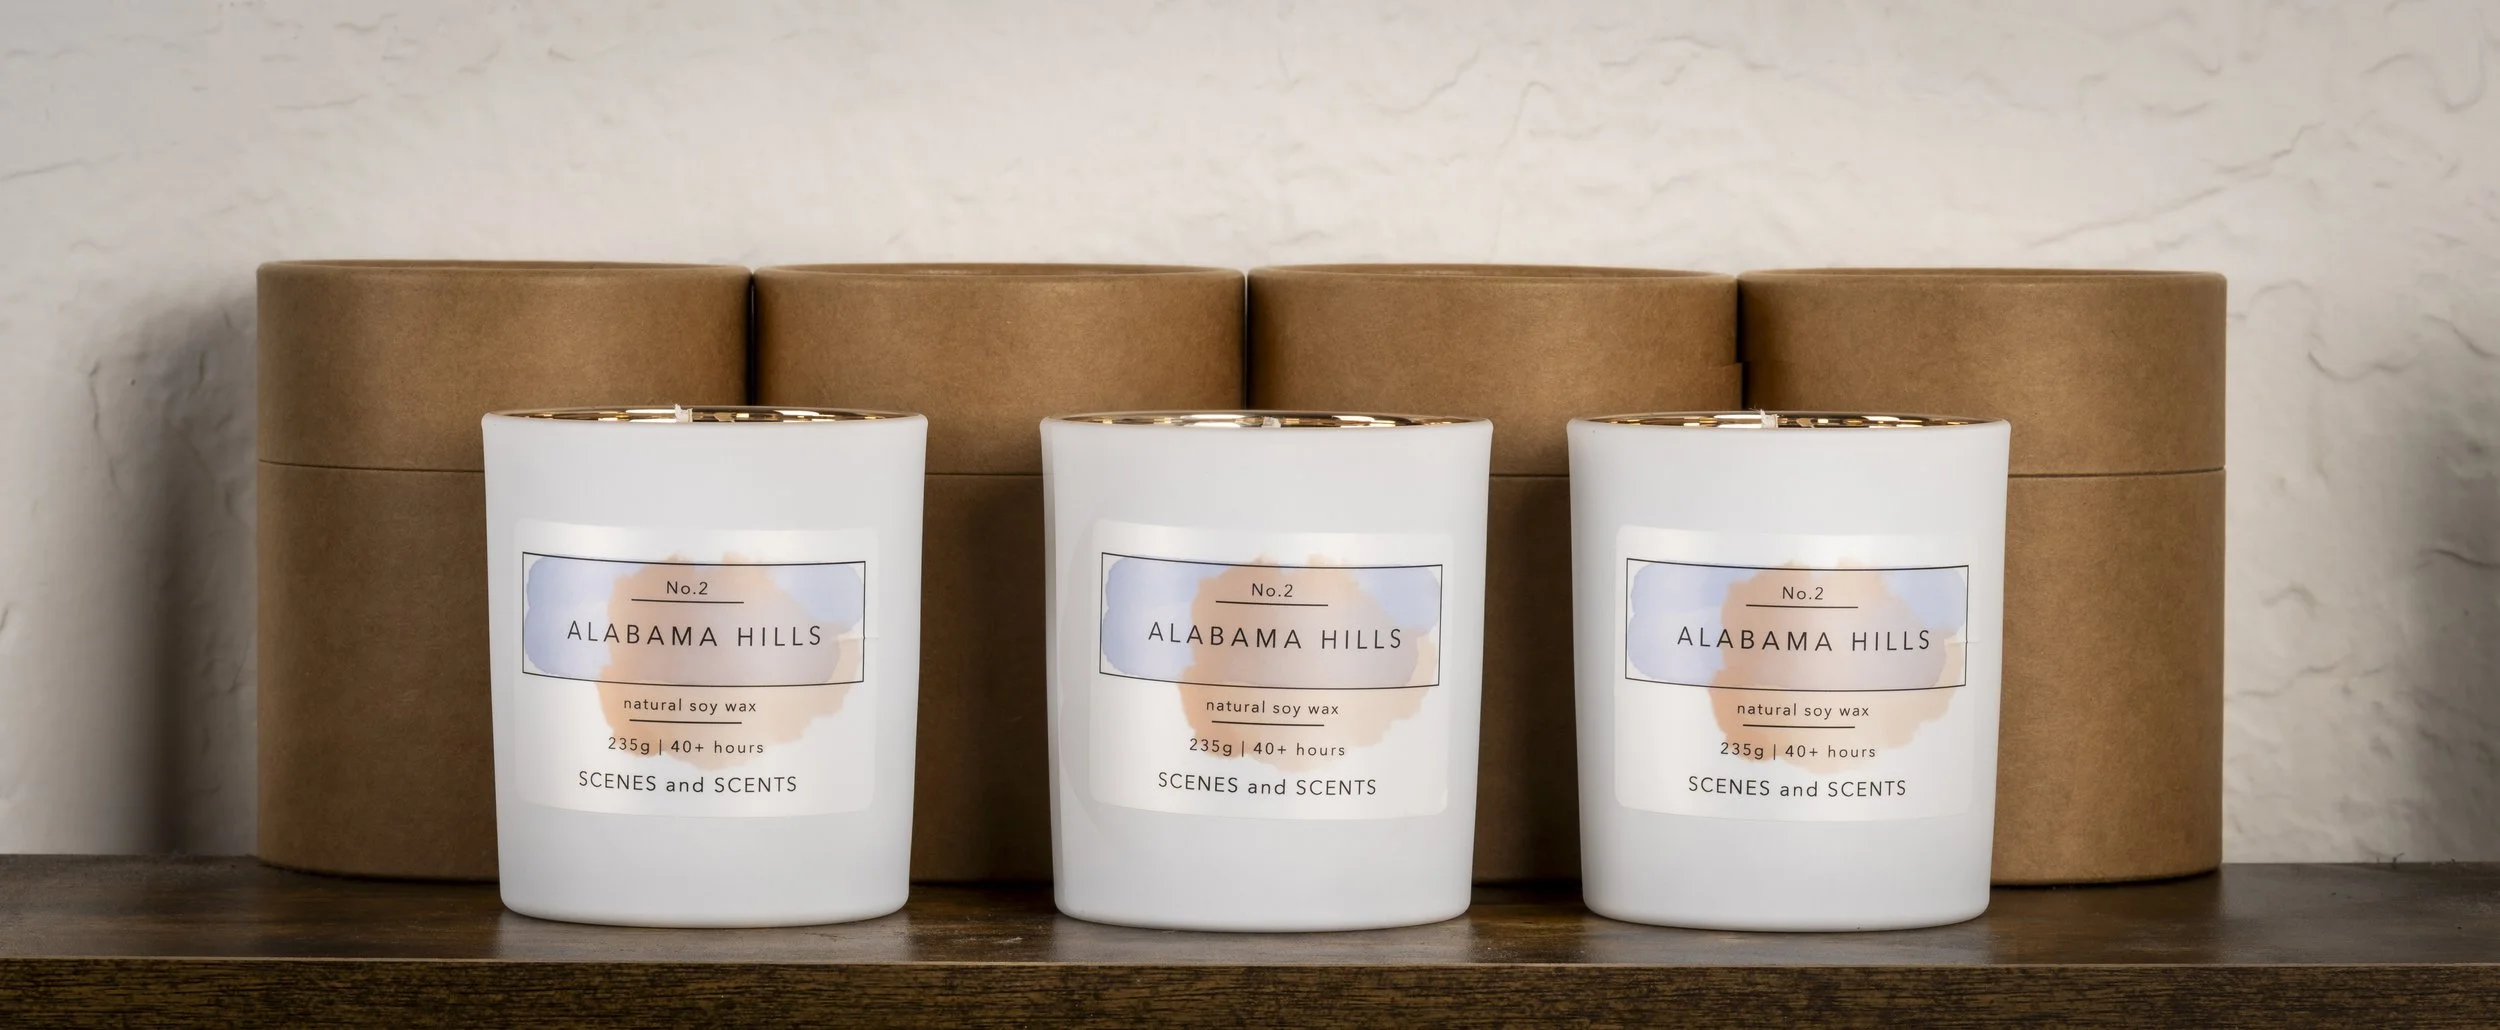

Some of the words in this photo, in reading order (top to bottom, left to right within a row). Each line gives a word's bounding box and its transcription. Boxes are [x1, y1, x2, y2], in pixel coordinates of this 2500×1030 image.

[666, 580, 708, 596] No.2
[1251, 582, 1294, 598] No.2
[1782, 585, 1824, 601] No.2
[566, 619, 718, 647] ALABAMA
[737, 625, 821, 647] HILLS
[1147, 621, 1302, 650] ALABAMA
[1321, 628, 1401, 650] HILLS
[1676, 625, 1833, 652] ALABAMA
[1851, 629, 1930, 652] HILLS
[623, 697, 682, 712] natural
[689, 702, 718, 716] soy
[724, 702, 757, 713] wax
[1206, 699, 1266, 714] natural
[1272, 704, 1302, 719] soy
[1307, 705, 1339, 715] wax
[1737, 702, 1797, 717] natural
[1803, 707, 1833, 721] soy
[1839, 707, 1870, 717] wax
[607, 736, 650, 756] 235g
[670, 739, 704, 754] 40+
[713, 739, 764, 754] hours
[1189, 737, 1233, 757] 235g
[1252, 741, 1287, 756] 40+
[1296, 742, 1345, 757] hours
[1720, 741, 1764, 761] 235g
[1784, 744, 1819, 758] 40+
[1827, 744, 1876, 759] hours
[578, 770, 657, 792] SCENES
[665, 776, 704, 793] and
[714, 775, 797, 794] SCENTS
[1158, 771, 1238, 794] SCENES
[1247, 778, 1286, 796] and
[1295, 778, 1377, 796] SCENTS
[1688, 775, 1770, 797] SCENES
[1779, 780, 1818, 798] and
[1827, 779, 1906, 798] SCENTS
